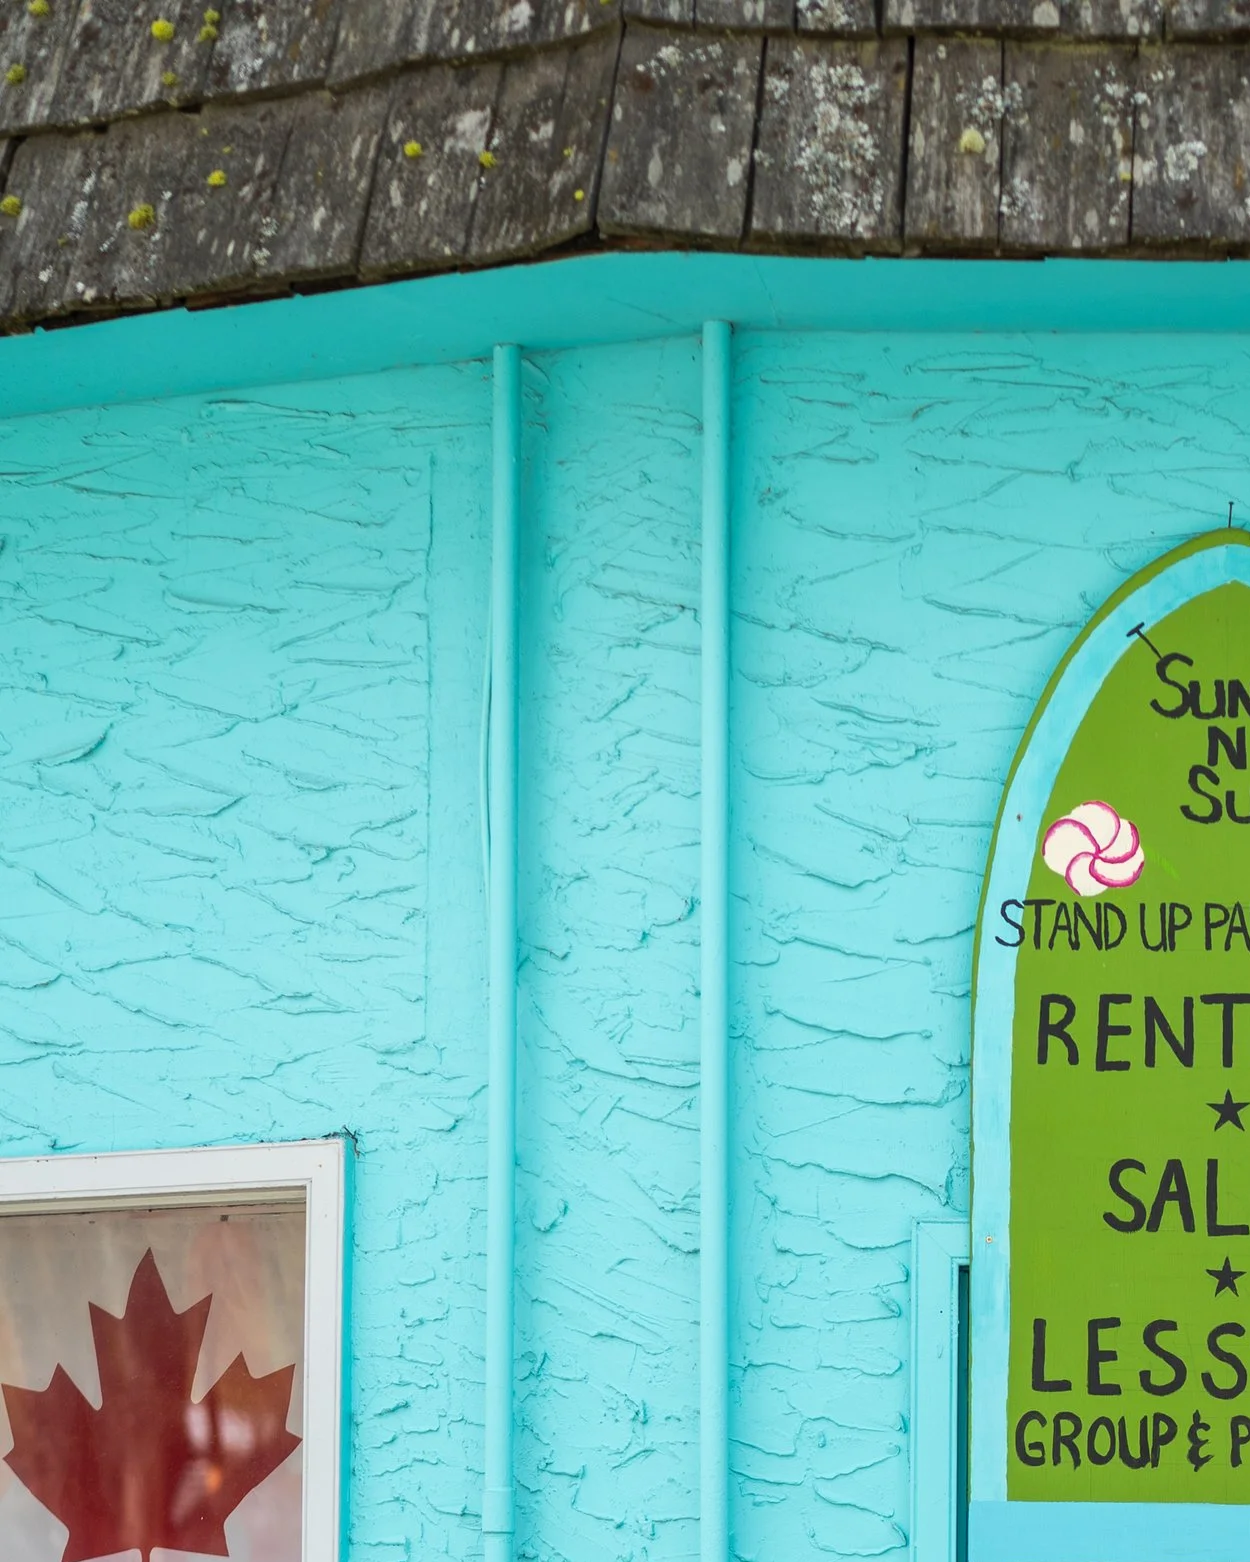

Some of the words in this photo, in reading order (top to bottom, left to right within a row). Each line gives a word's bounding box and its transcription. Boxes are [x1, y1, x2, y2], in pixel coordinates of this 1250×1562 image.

[1207, 725, 1248, 770] N
[994, 899, 1127, 952] STAND
[1139, 902, 1193, 952] UP
[1015, 1410, 1178, 1470] GROUP
[1186, 1409, 1213, 1472] &
